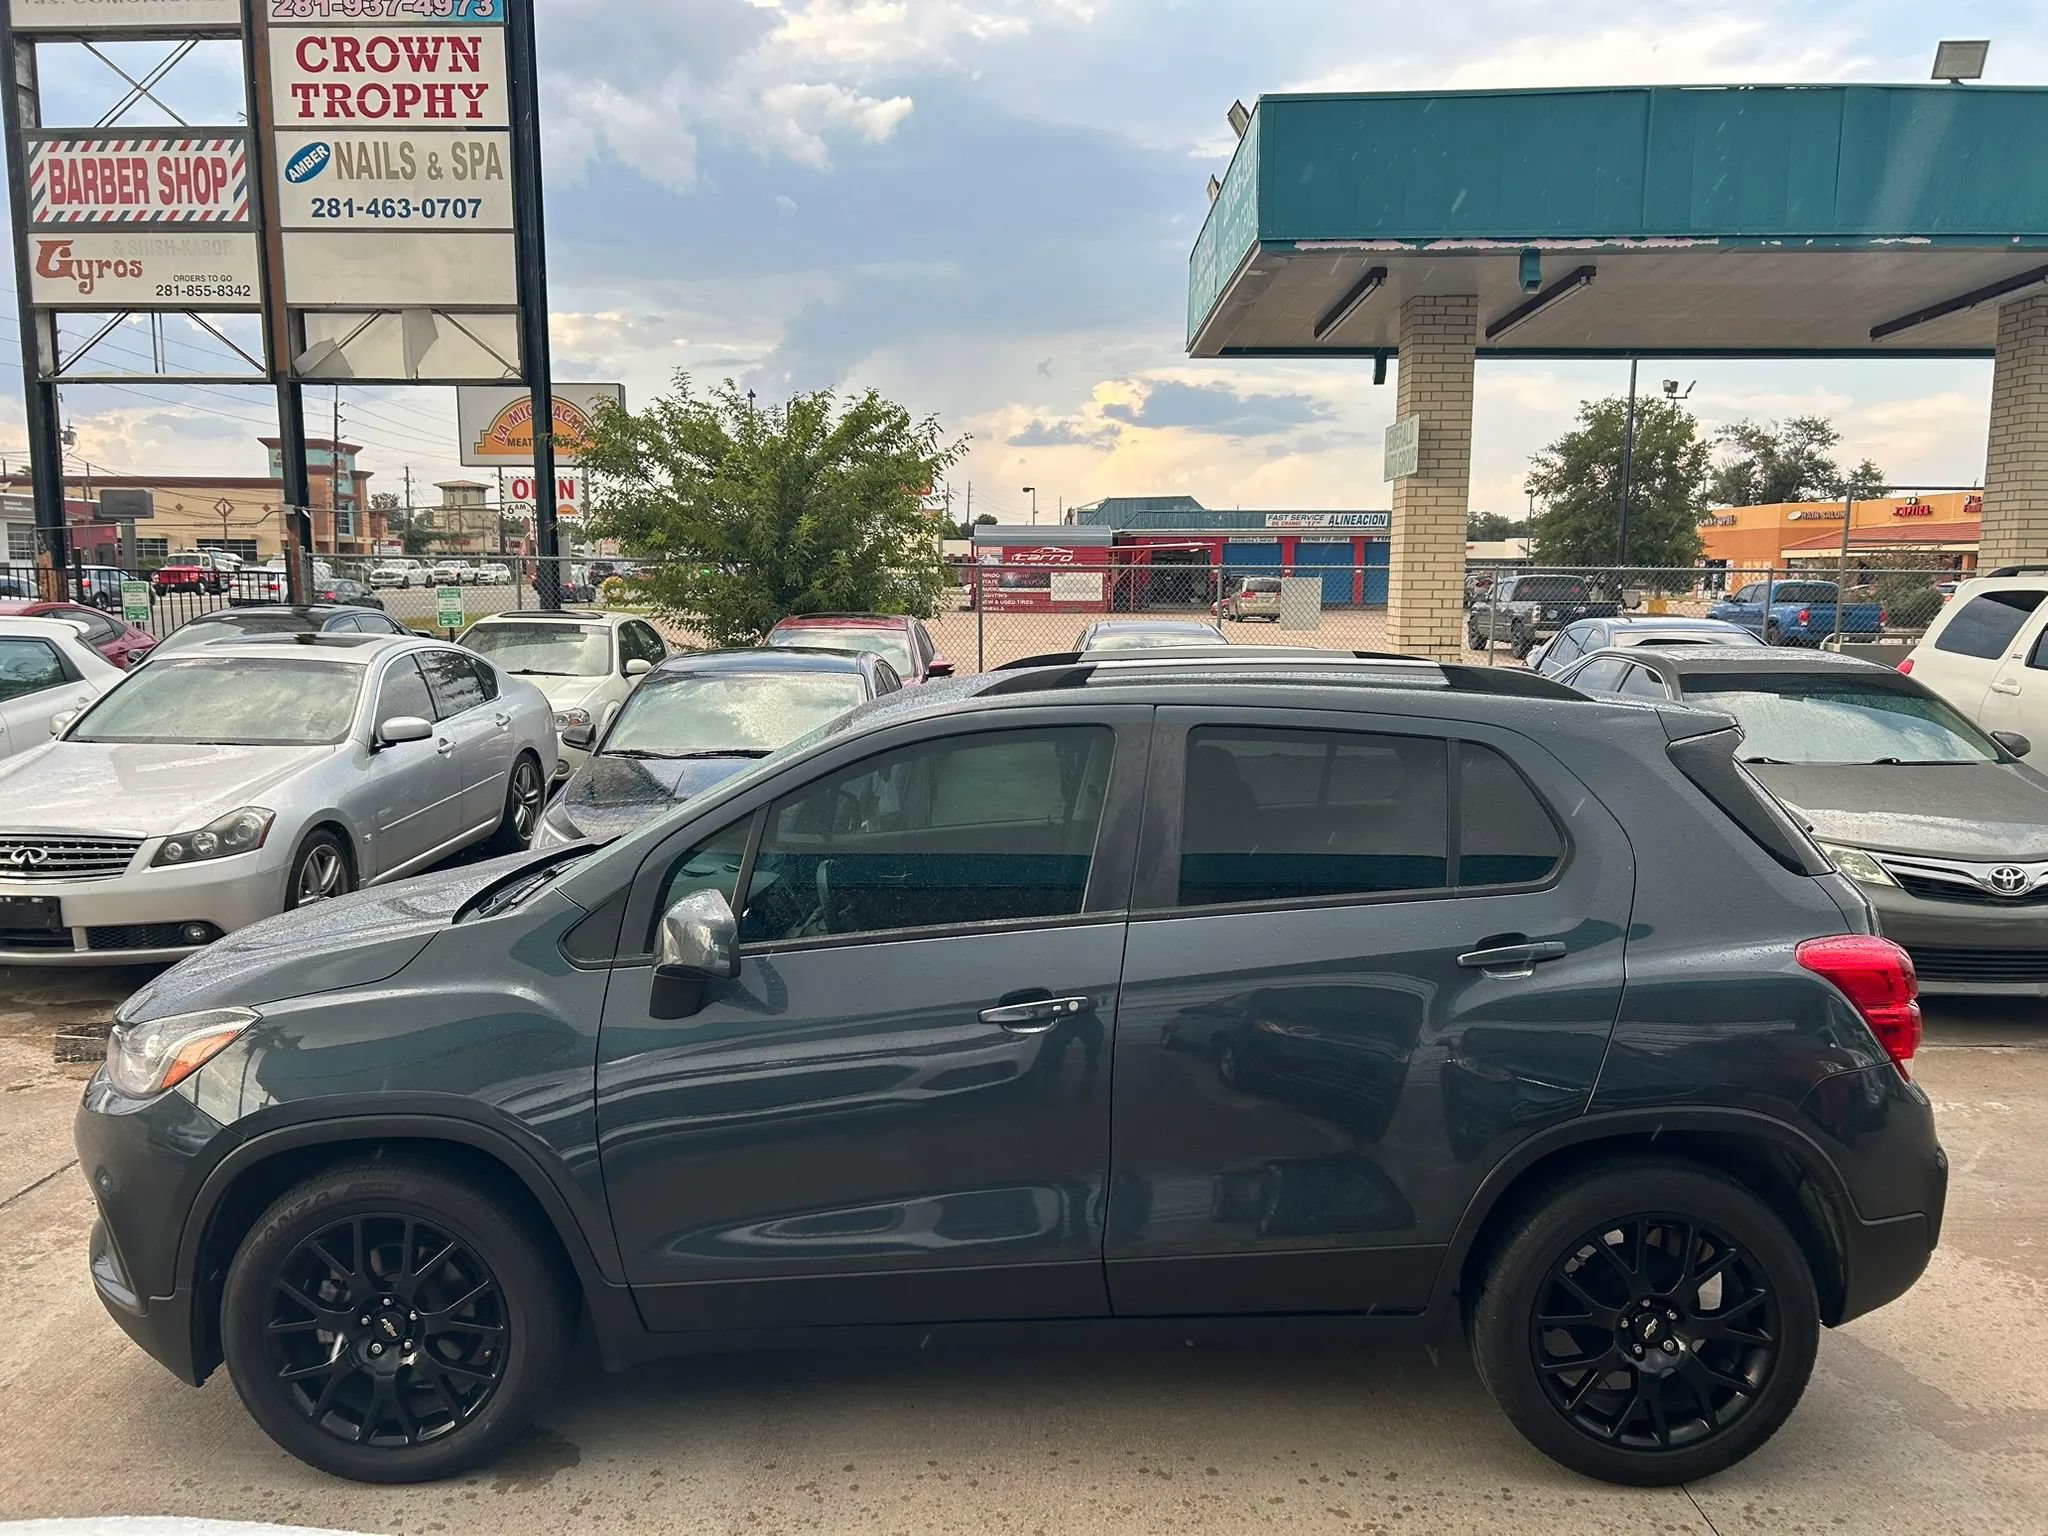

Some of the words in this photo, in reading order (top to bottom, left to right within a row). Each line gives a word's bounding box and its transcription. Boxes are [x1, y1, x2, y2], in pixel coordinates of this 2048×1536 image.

[296, 36, 482, 73] CROWN
[291, 83, 489, 118] TROPHY
[288, 145, 329, 182] AMBER
[334, 141, 416, 180] NAILS
[427, 152, 443, 180] &
[452, 141, 504, 180] SPA
[48, 158, 150, 205] BARBER
[157, 156, 227, 205] SHOP
[311, 197, 482, 218] 281-463-0707
[36, 240, 143, 295] Gyros
[155, 285, 251, 297] 281-855-8342
[493, 424, 511, 445] LA
[512, 479, 575, 500] ON
[1328, 515, 1385, 525] ALINEACION
